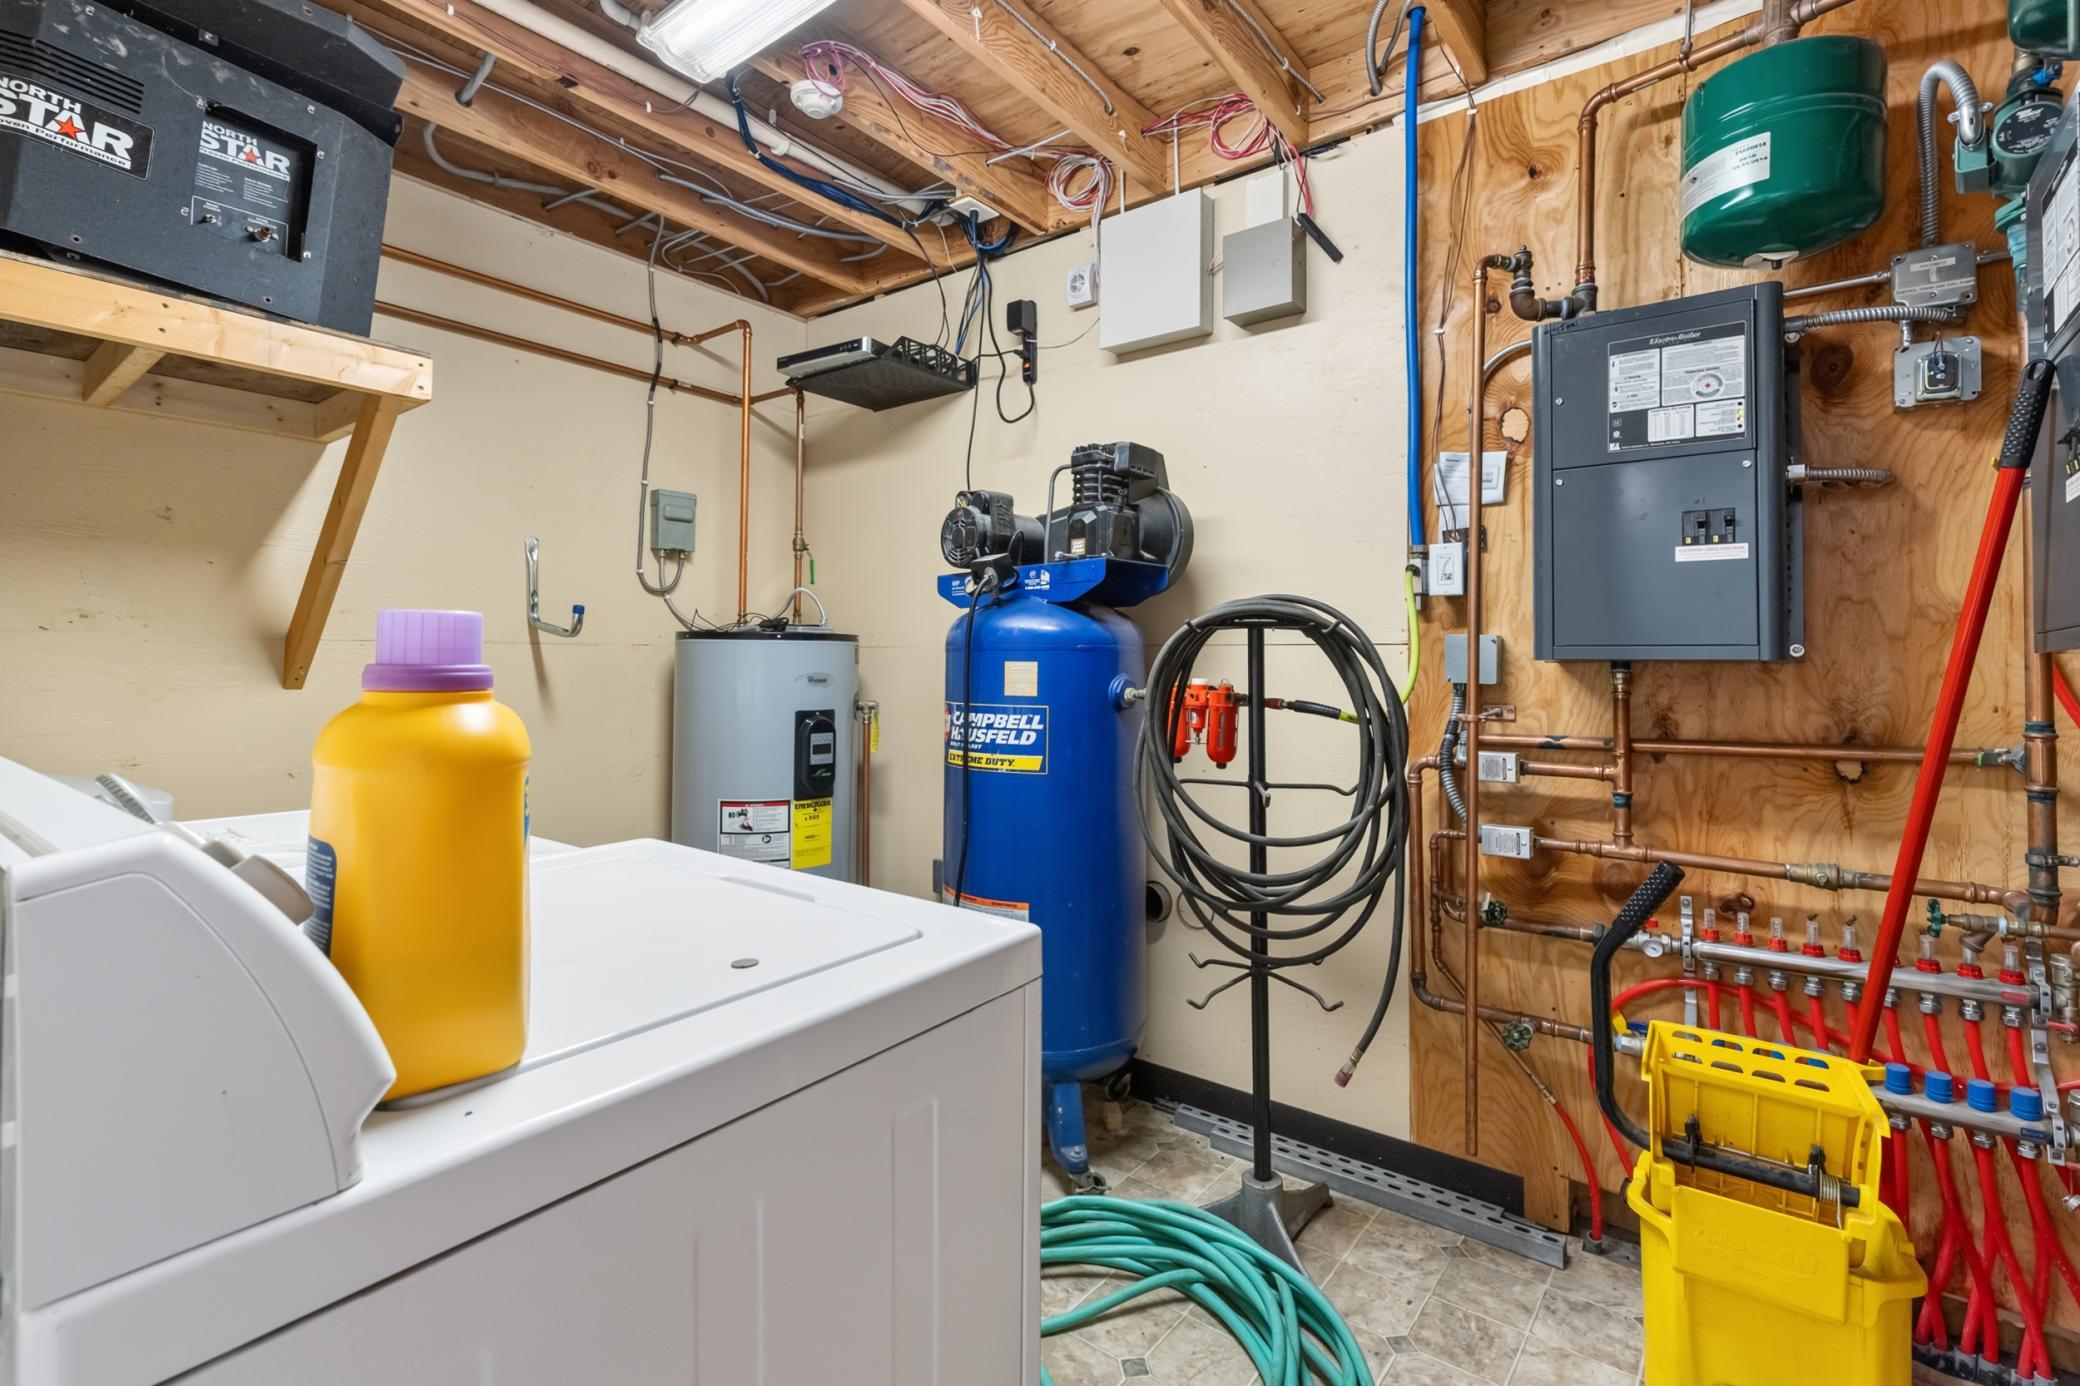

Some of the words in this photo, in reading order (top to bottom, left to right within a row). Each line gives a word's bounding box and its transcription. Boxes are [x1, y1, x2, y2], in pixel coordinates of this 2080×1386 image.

[35, 127, 126, 166] Performance
[202, 121, 258, 146] NORTH
[200, 128, 290, 175] STAR
[949, 753, 982, 765] EXTME
[985, 757, 1015, 767] DUTY
